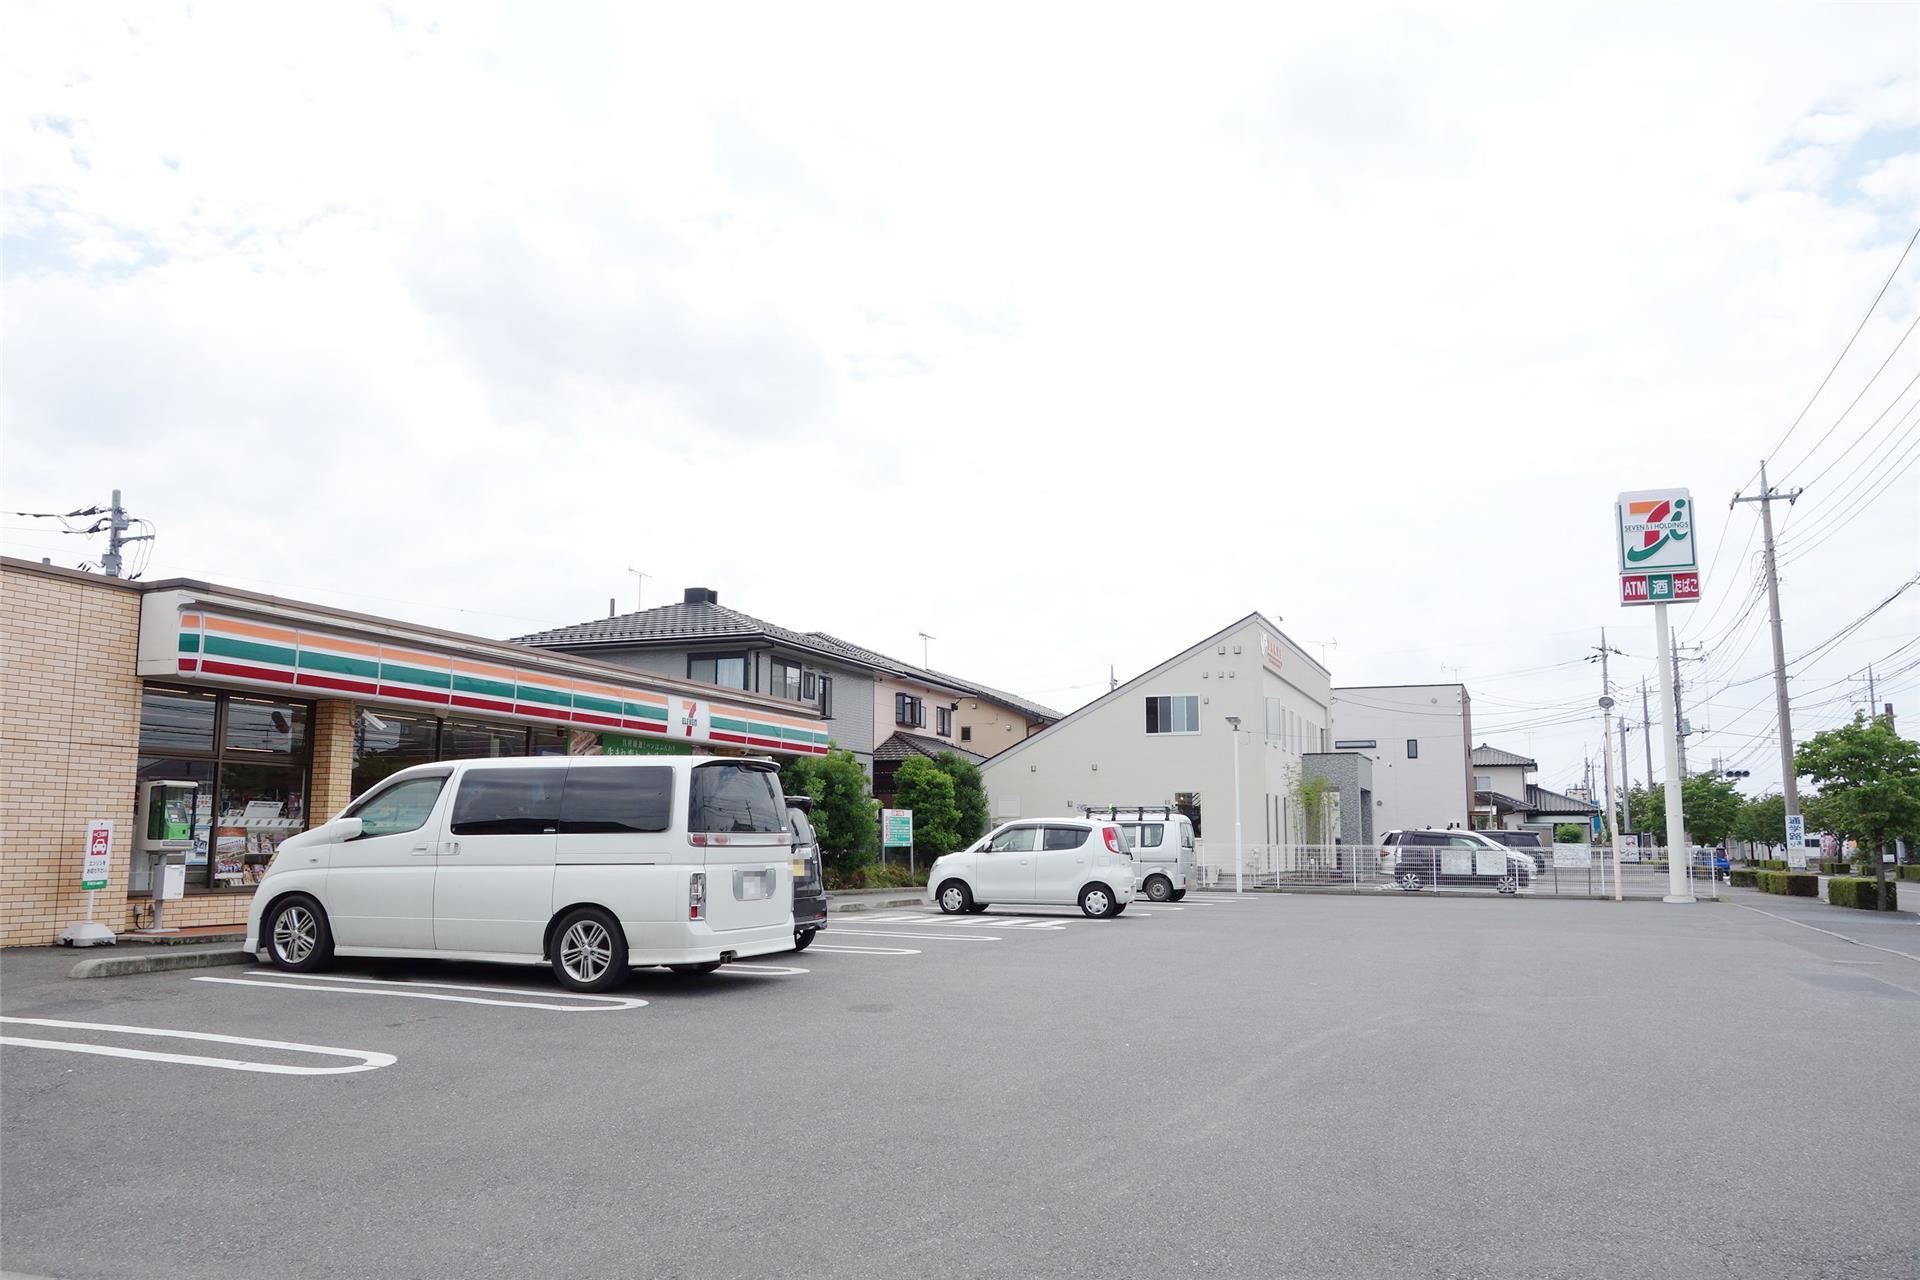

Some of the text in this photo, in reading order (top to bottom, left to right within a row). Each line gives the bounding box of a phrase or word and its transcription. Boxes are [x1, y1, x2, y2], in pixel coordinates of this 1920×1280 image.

[1624, 524, 1645, 532] SEVEN
[1654, 521, 1689, 530] HOLDINGS
[1624, 580, 1647, 596] ATM
[1652, 579, 1669, 595] 酒
[1673, 578, 1699, 593] たばこ
